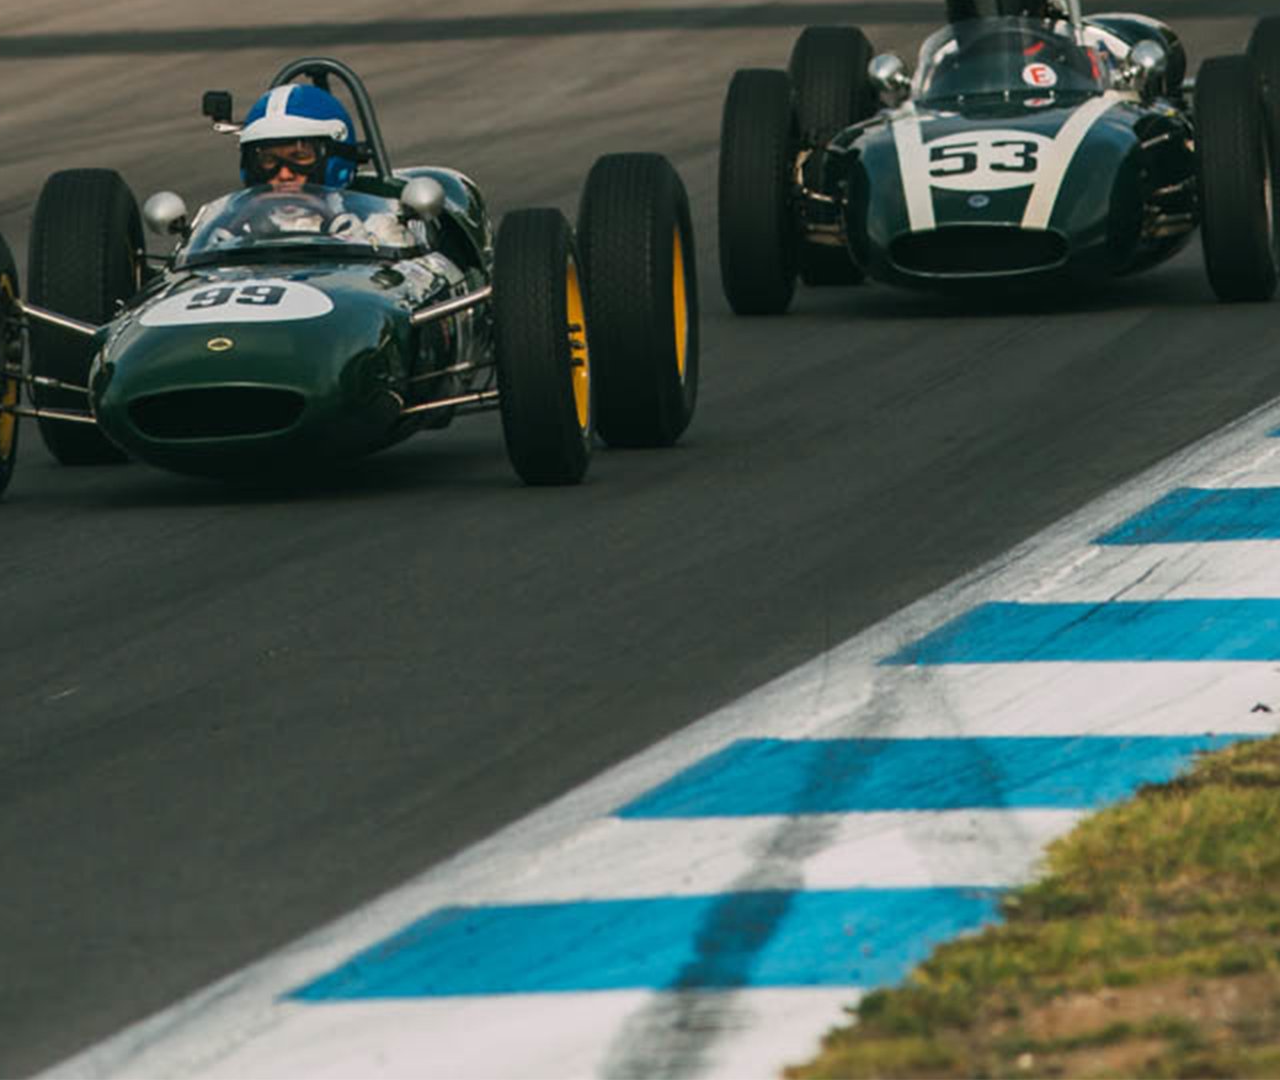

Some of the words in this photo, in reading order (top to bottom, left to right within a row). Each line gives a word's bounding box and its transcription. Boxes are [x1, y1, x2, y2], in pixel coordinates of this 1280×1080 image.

[1030, 66, 1052, 84] E
[928, 140, 1039, 178] 53
[185, 285, 287, 310] 99
